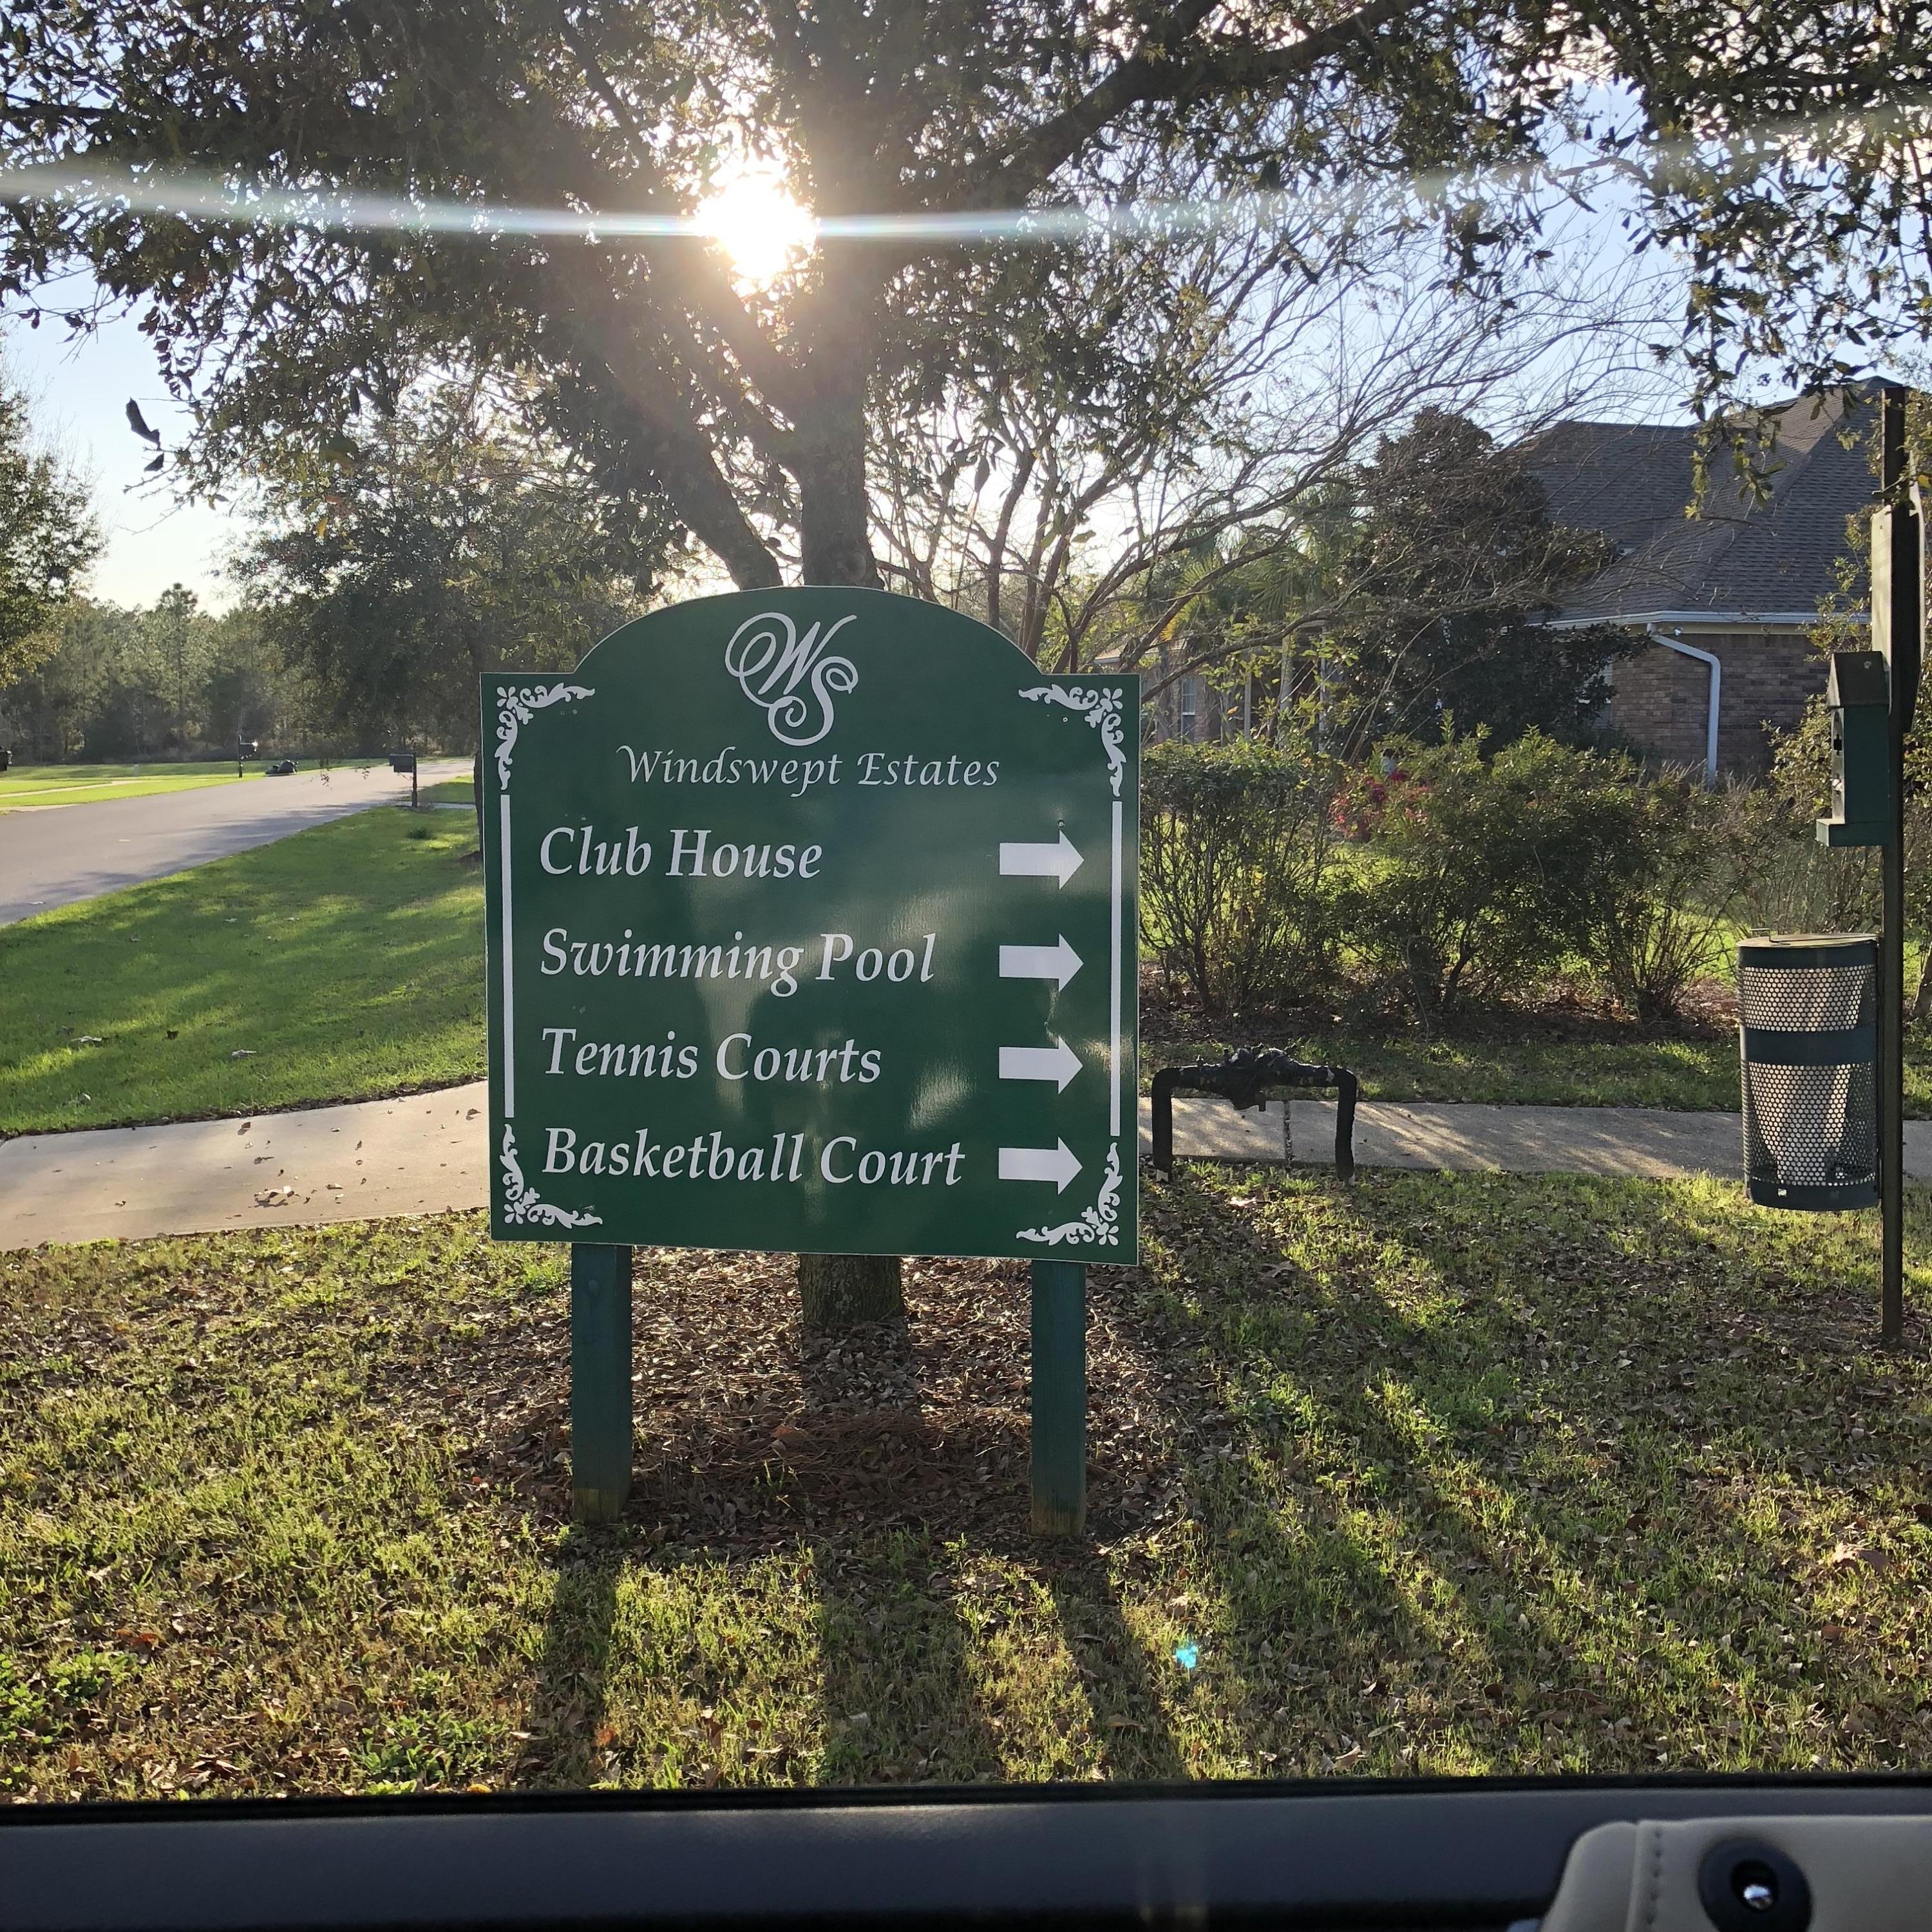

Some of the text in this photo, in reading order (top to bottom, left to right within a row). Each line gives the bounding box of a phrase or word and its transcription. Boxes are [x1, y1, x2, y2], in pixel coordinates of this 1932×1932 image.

[616, 746, 999, 797] Windswept Estates
[541, 826, 822, 878] Club House
[541, 928, 936, 997] Swimming Pool
[542, 1028, 881, 1083] Tennis Courts
[542, 1128, 965, 1185] Basketball Court
